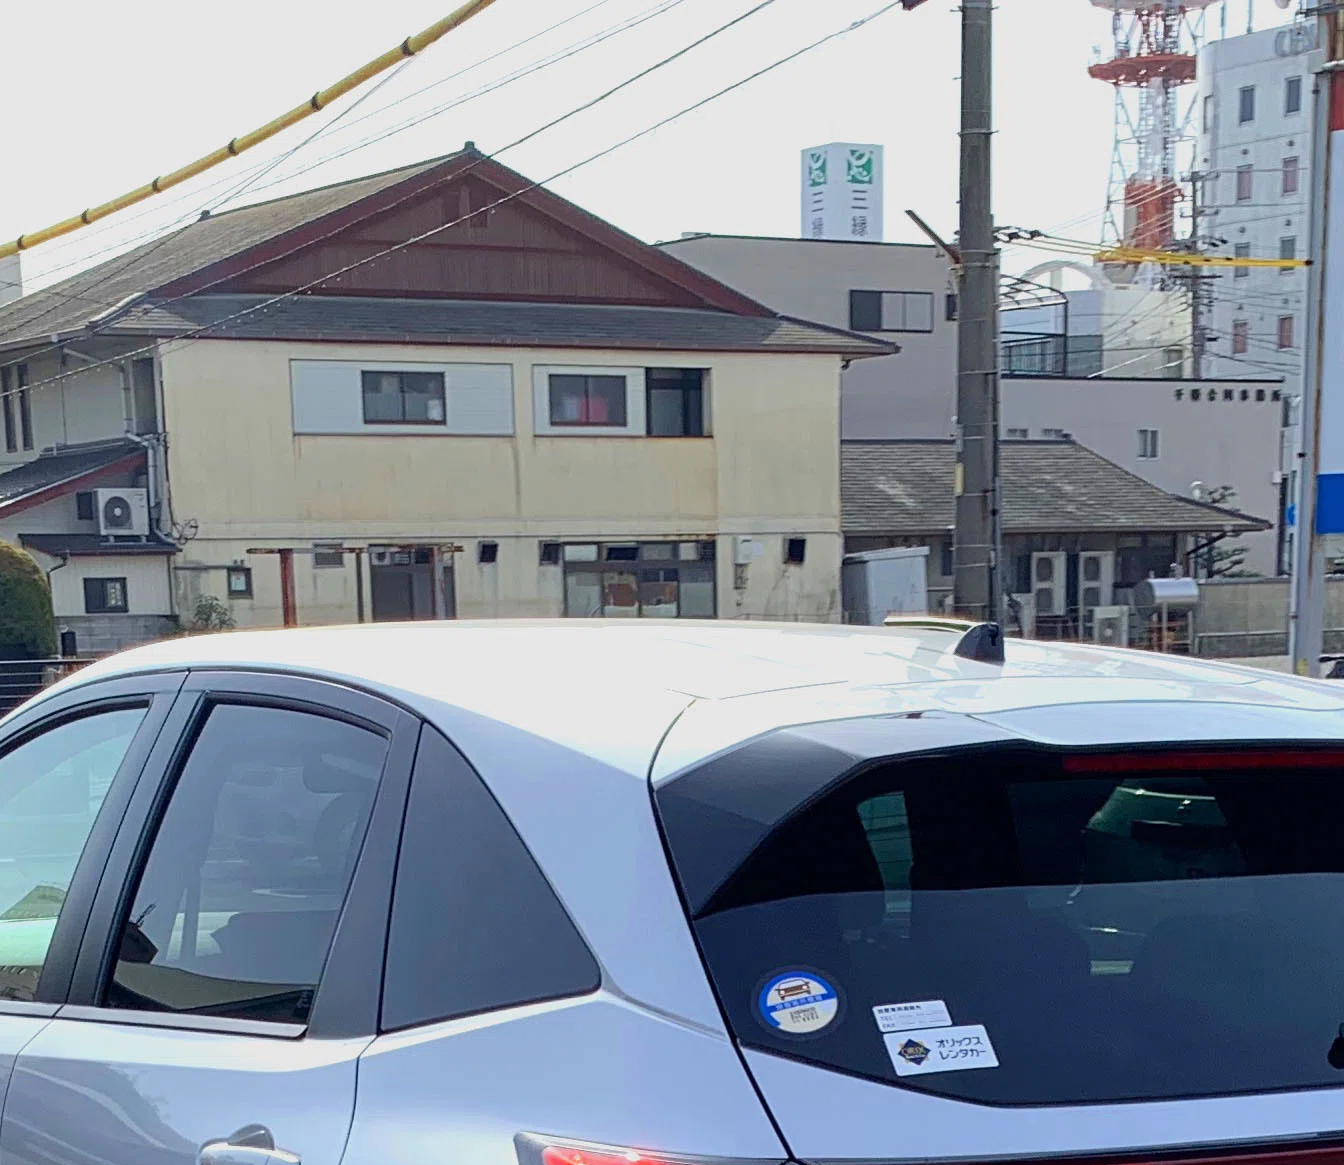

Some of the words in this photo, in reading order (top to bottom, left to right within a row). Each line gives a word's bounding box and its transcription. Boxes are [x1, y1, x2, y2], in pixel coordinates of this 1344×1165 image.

[936, 1036, 984, 1049] オリックス
[938, 1048, 988, 1060] レンタカー
